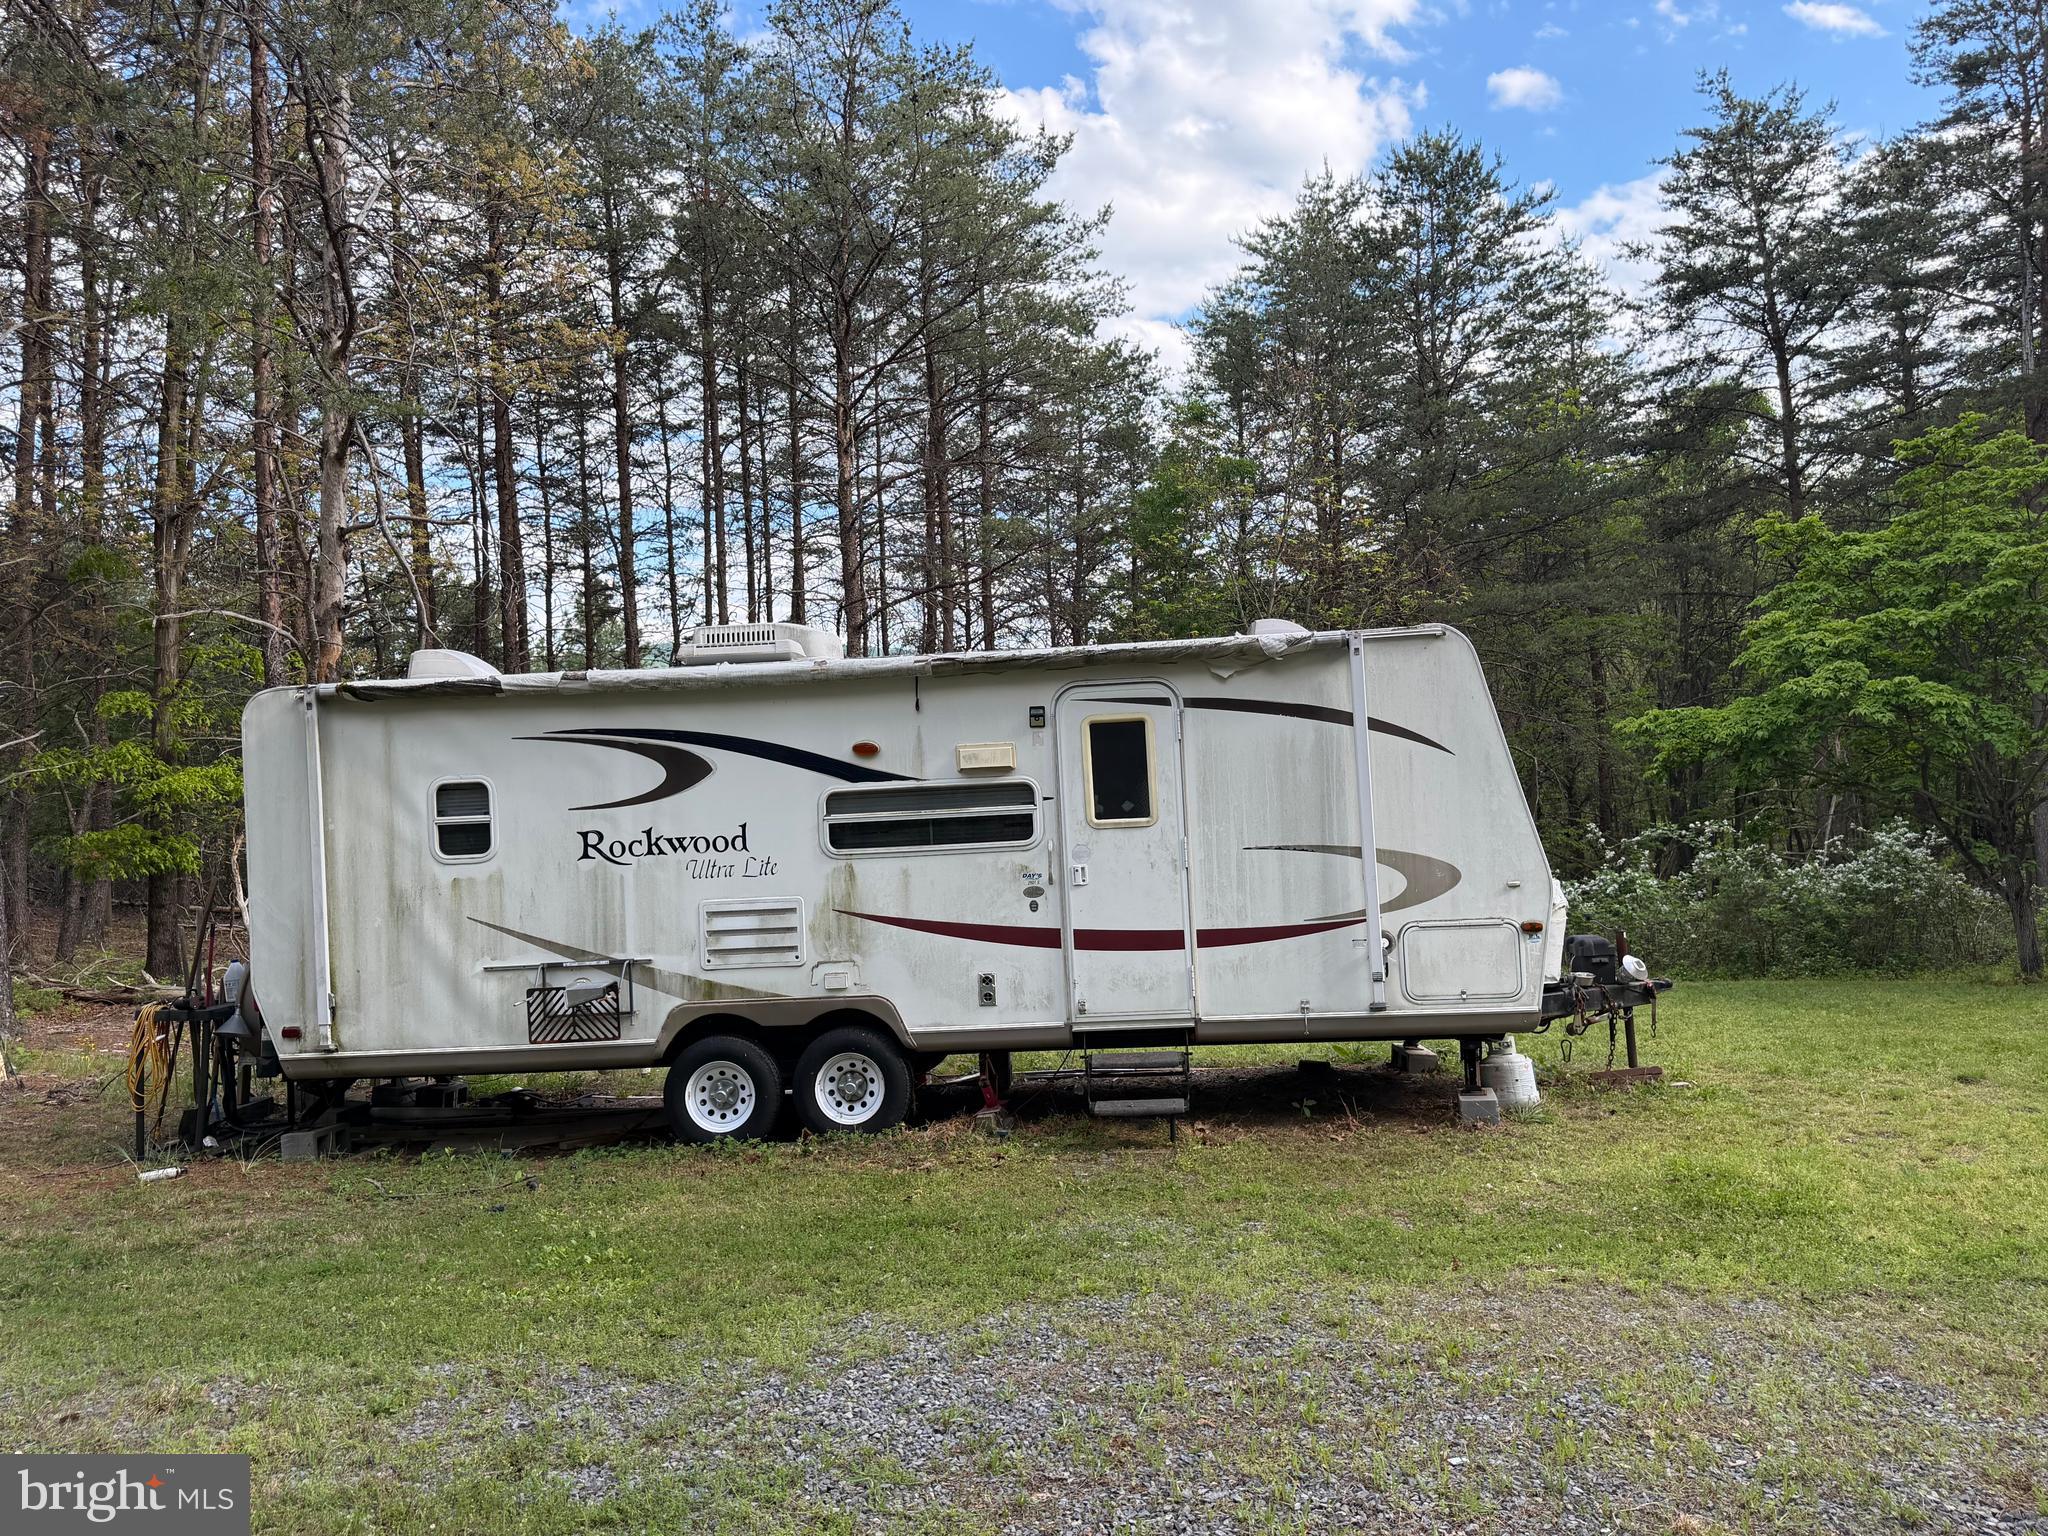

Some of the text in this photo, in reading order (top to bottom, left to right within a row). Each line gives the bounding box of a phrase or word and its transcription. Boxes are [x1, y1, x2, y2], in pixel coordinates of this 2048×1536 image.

[576, 822, 750, 866] Rockwood
[685, 855, 779, 880] Ultra Lite
